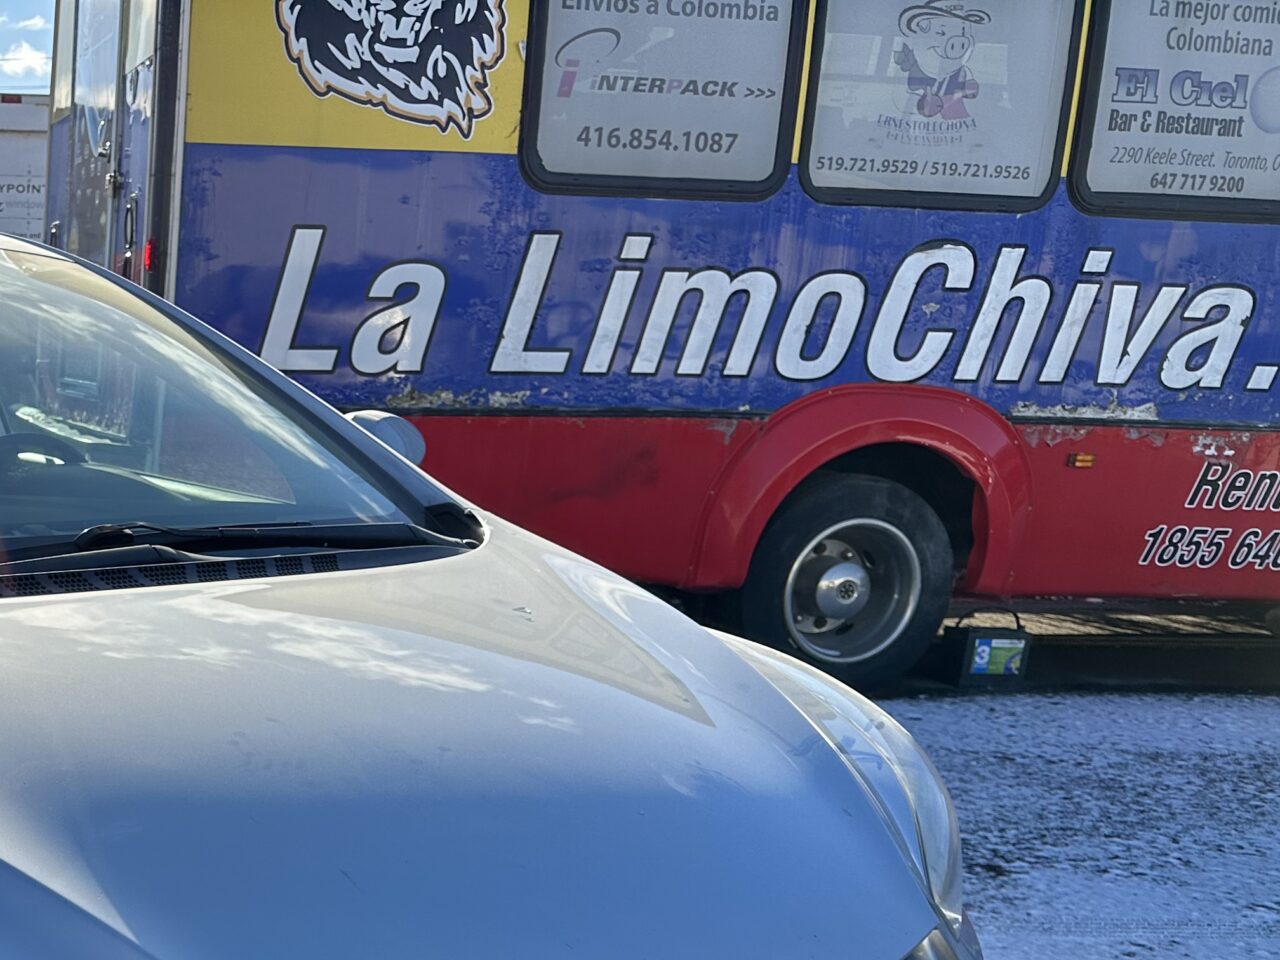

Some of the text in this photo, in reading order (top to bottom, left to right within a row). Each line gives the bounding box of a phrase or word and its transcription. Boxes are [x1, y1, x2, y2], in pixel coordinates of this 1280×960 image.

[645, 0, 659, 15] a
[666, 0, 779, 21] Colombia
[1149, 0, 1170, 17] La
[1175, 0, 1230, 25] mejor
[1166, 27, 1273, 56] Colombiana
[1111, 67, 1160, 104] El
[1107, 109, 1245, 138] Bar & Restaurant
[576, 125, 739, 154] 416.854.1087
[816, 156, 919, 175] 519.721.9529
[930, 161, 1031, 181] 519.721.9526
[1109, 146, 1143, 164] 2290
[1144, 147, 1177, 166] Keele
[1178, 148, 1216, 168] Street.
[1223, 151, 1269, 172] Toronto,
[1150, 172, 1245, 193] 647 717 9200
[260, 225, 1280, 391] La LimoChiva.
[1138, 525, 1232, 568] 1855
